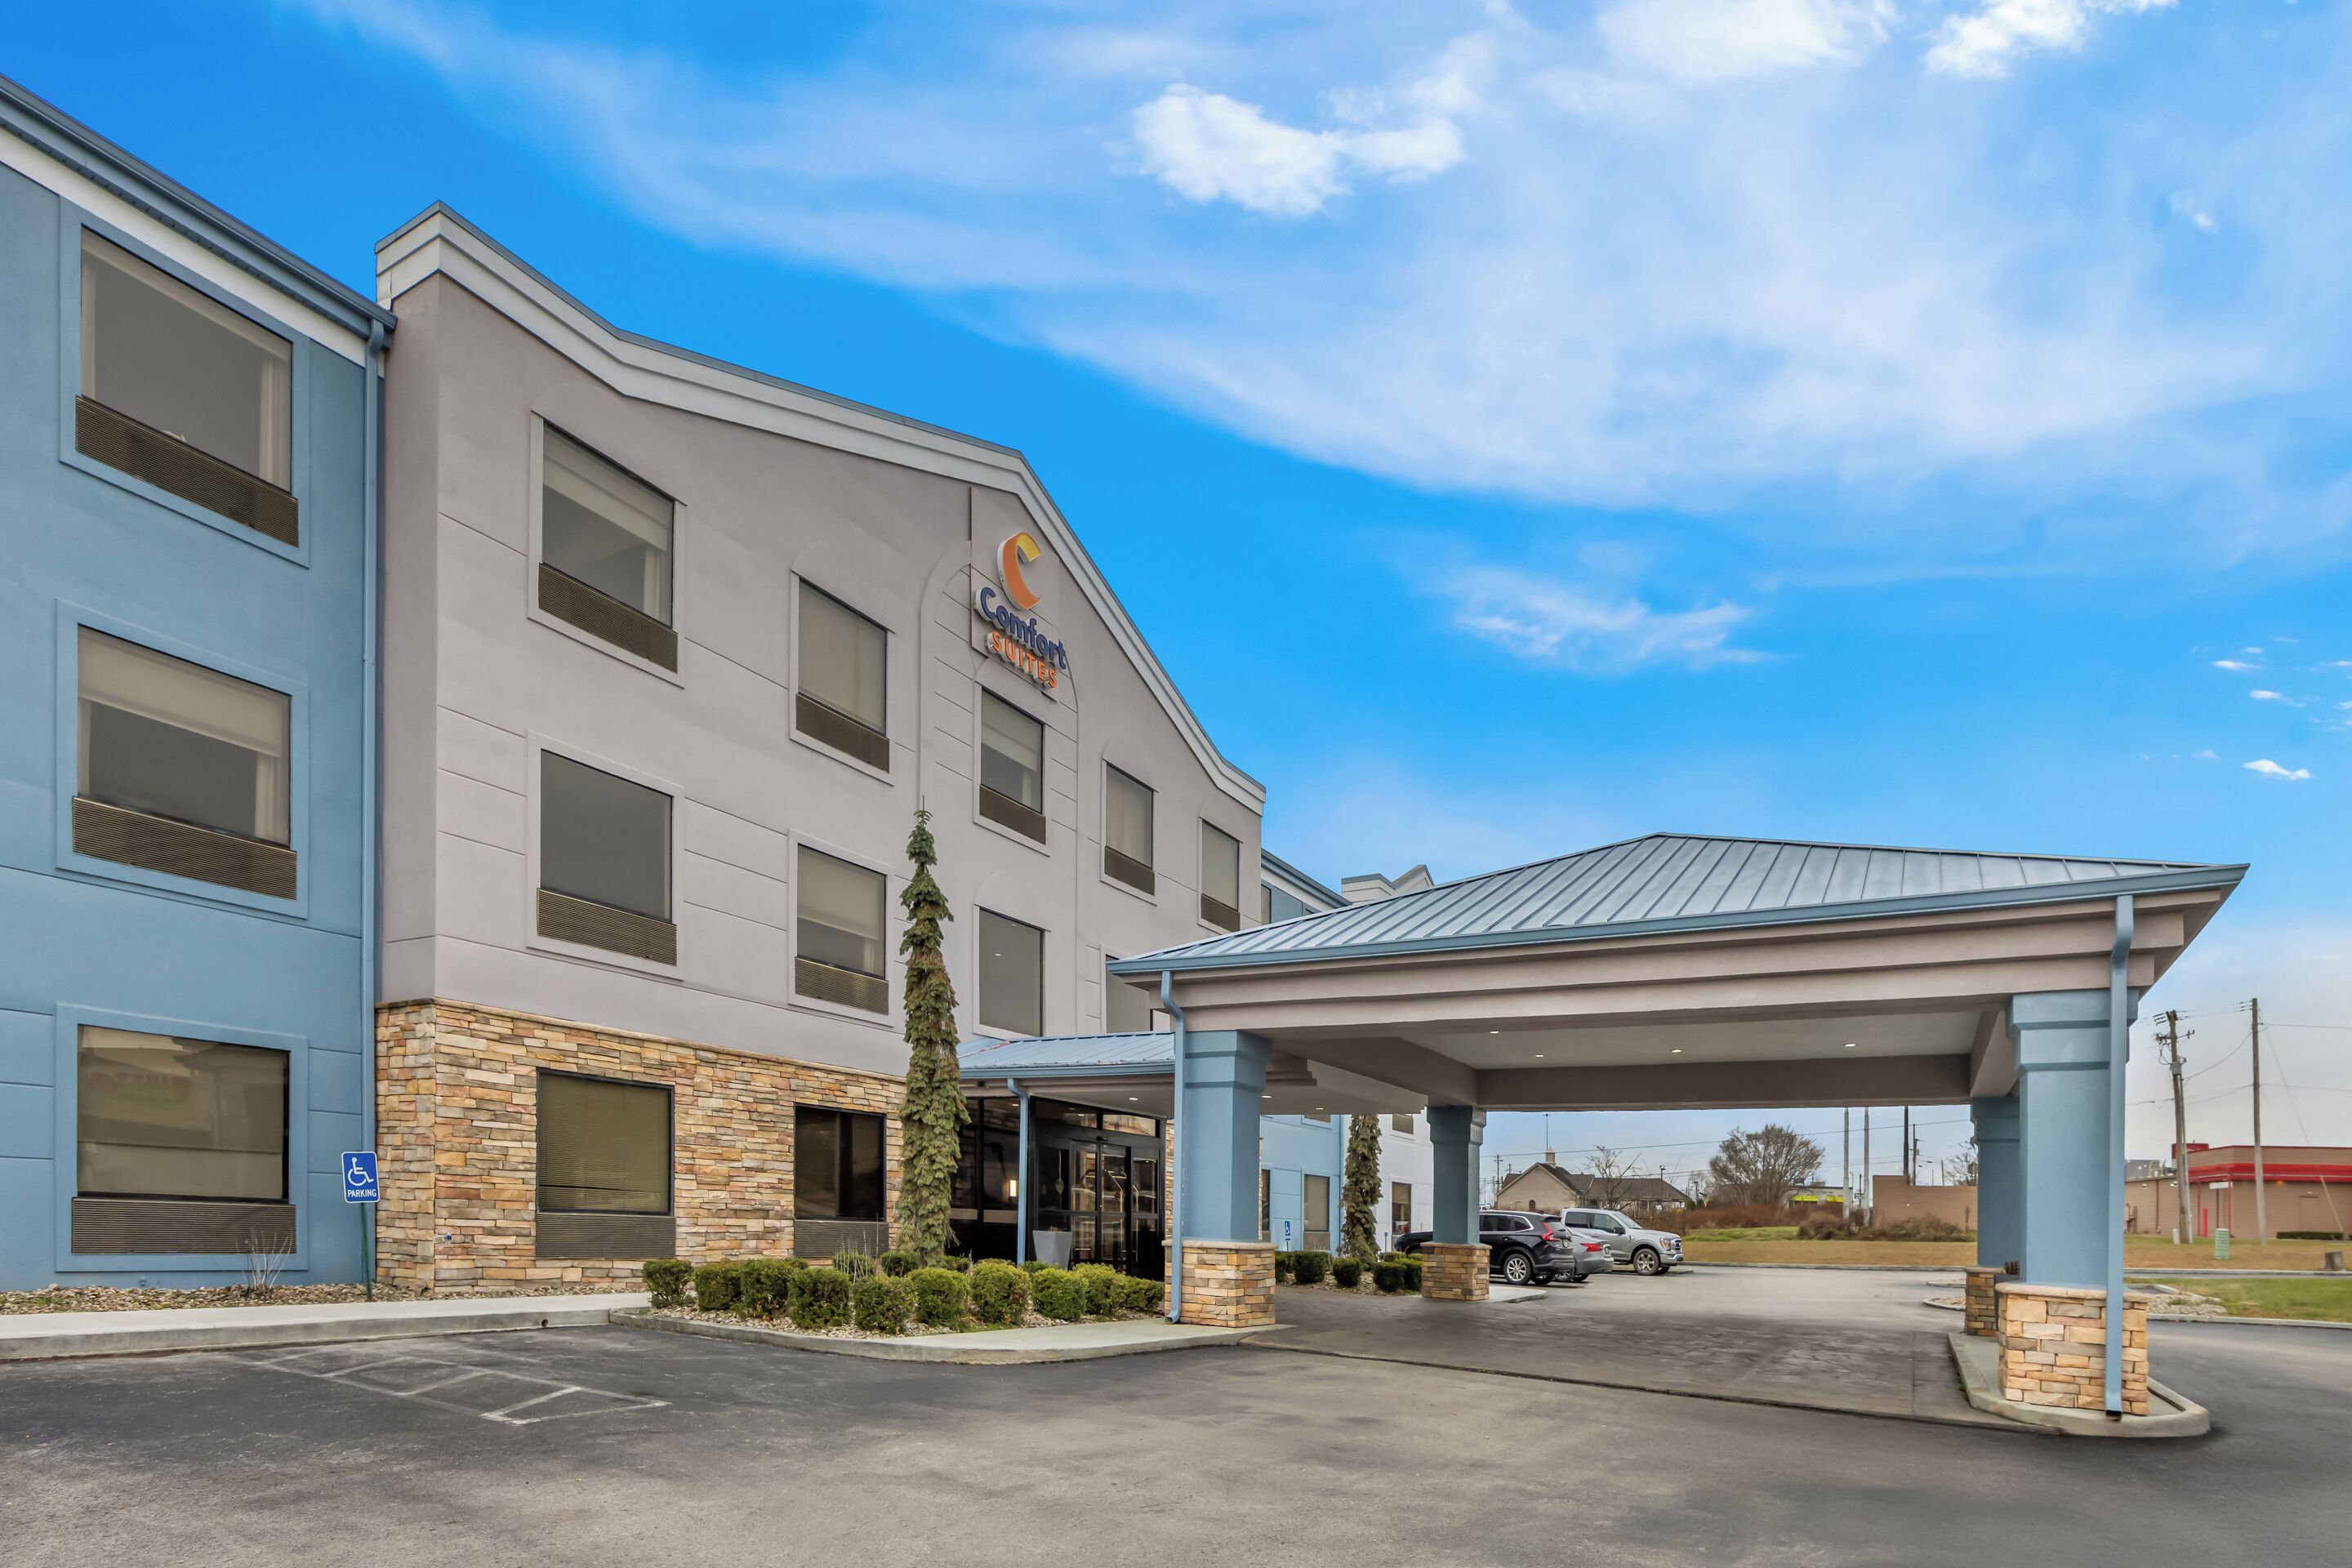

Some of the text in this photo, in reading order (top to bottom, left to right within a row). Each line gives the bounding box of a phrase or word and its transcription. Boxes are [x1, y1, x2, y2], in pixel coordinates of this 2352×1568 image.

[978, 586, 1067, 670] Comfort
[991, 630, 1058, 688] SUITES
[347, 1189, 377, 1198] PARKING
